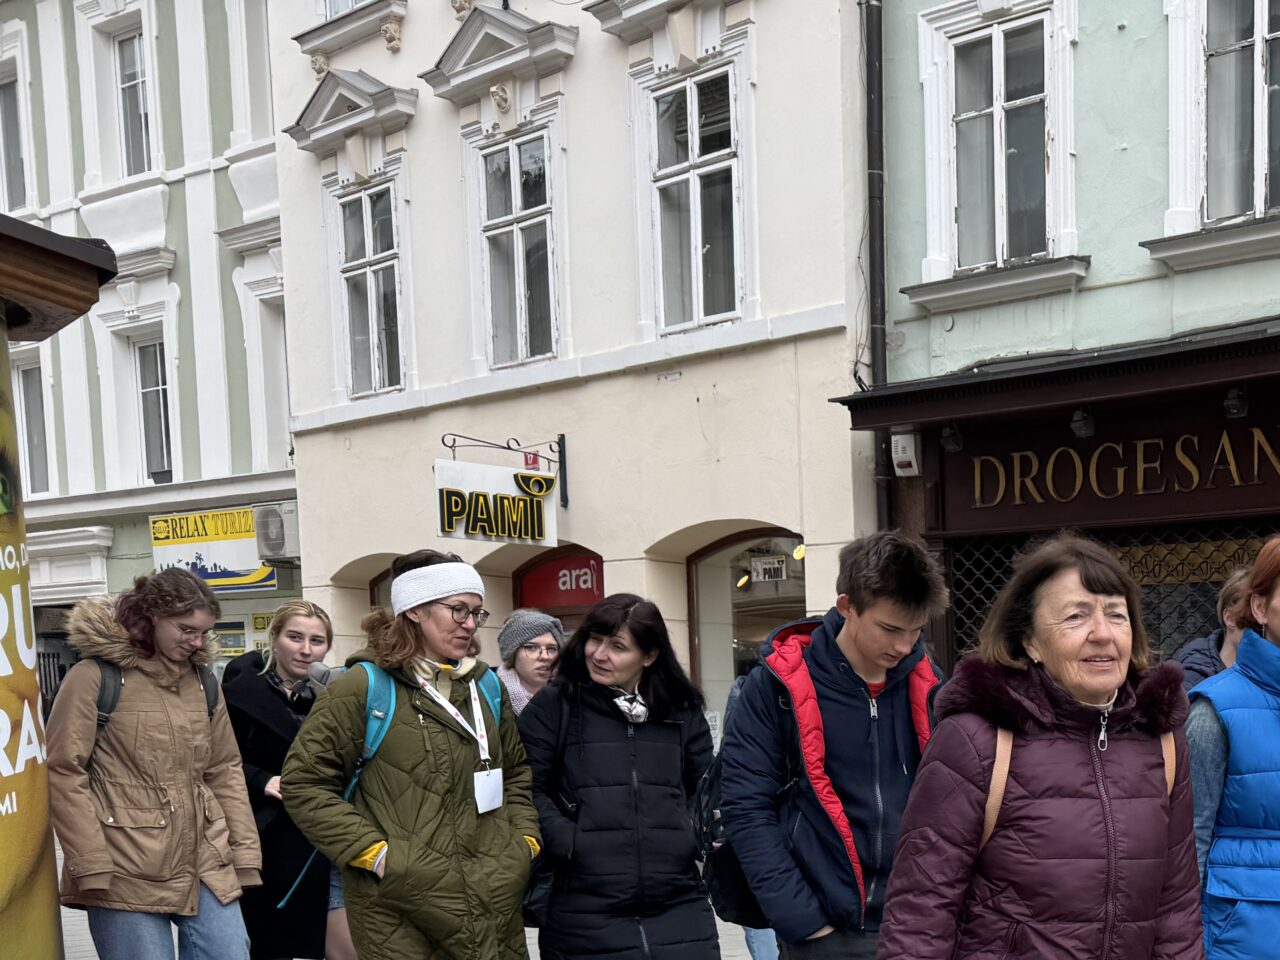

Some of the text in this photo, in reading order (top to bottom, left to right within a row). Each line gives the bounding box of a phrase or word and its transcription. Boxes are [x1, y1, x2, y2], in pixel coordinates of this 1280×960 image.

[438, 487, 546, 540] PAMI
[170, 514, 209, 540] RELAX
[763, 566, 783, 580] PAMI
